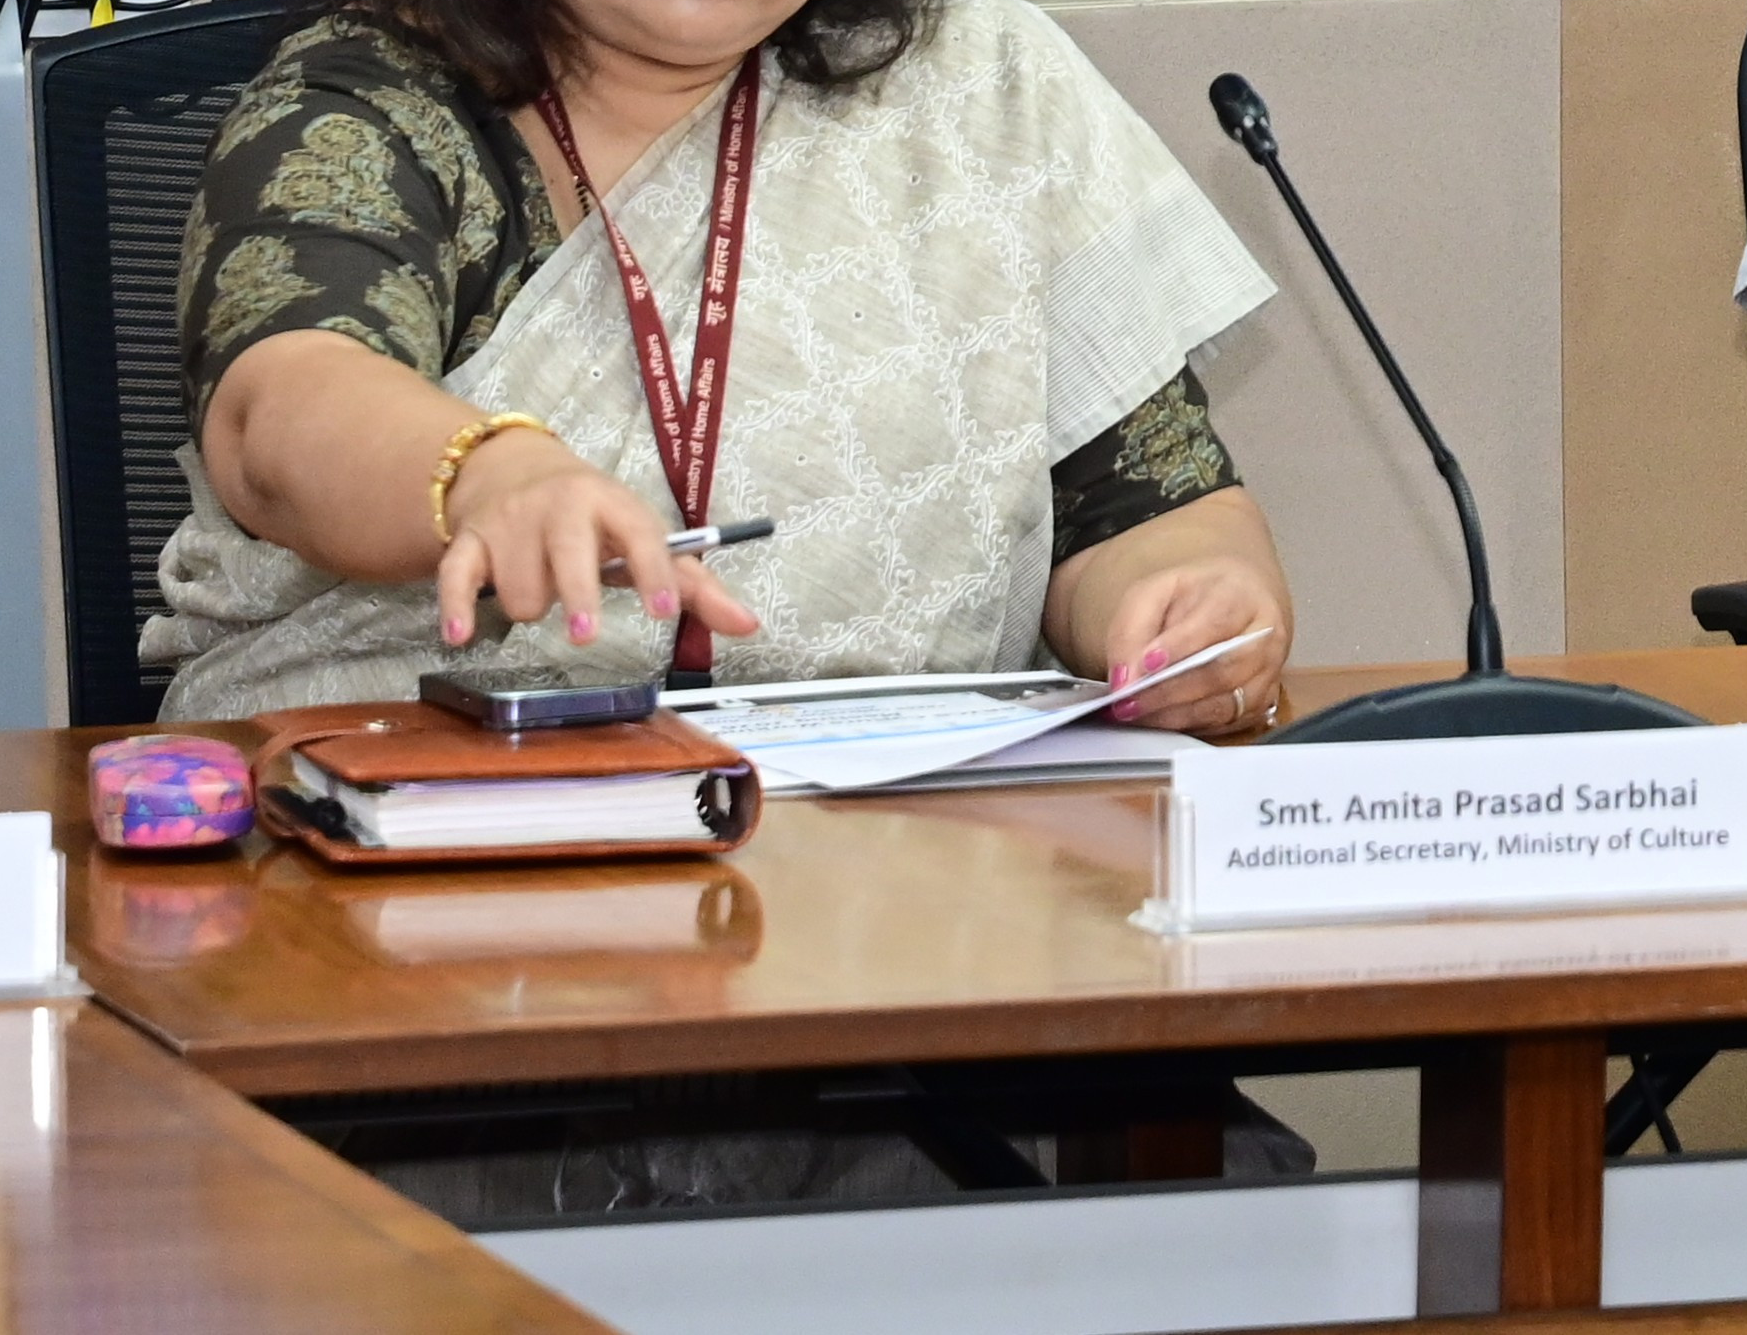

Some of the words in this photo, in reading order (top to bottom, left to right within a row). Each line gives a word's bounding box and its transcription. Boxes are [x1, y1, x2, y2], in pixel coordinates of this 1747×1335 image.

[726, 123, 744, 159] Home
[724, 158, 739, 173] of
[718, 174, 740, 223] Ministry
[705, 234, 731, 295] मंत्रालय
[705, 298, 728, 326] गृह
[647, 333, 667, 377] Affairs
[656, 378, 677, 420] Home
[696, 357, 716, 400] Affairs
[663, 421, 681, 437] of
[691, 400, 711, 440] Home
[688, 439, 704, 456] of
[686, 456, 705, 511] Ministry
[1258, 798, 1333, 827] Smt.
[1343, 791, 1443, 823] Amita
[1454, 783, 1564, 818] Prasad
[1575, 777, 1698, 813] Sarbhai
[1227, 843, 1356, 870] Additional
[1365, 838, 1489, 864] Secretary,
[1497, 832, 1600, 857] Ministry
[1607, 827, 1632, 852] of
[1639, 826, 1730, 850] Culture
